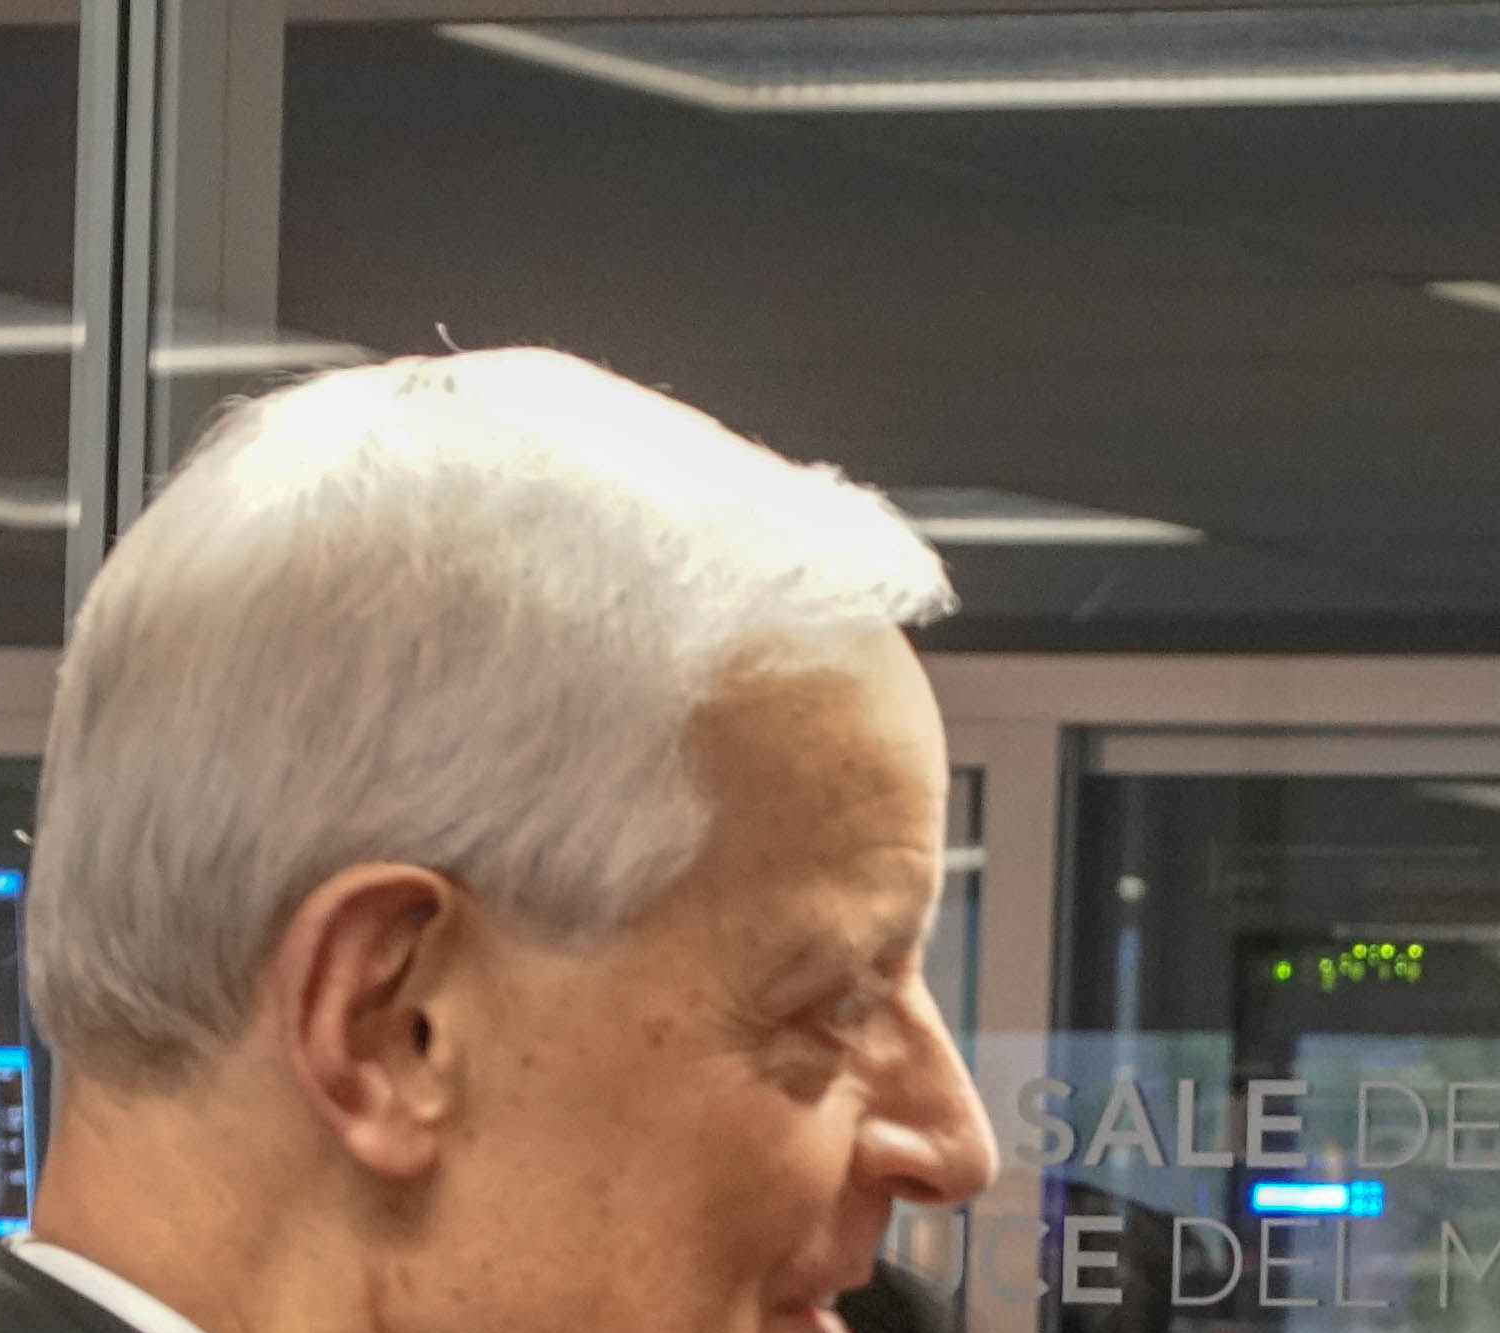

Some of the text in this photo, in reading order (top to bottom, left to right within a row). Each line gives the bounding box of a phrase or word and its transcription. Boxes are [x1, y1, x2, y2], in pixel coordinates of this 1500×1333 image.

[1014, 1077, 1310, 1169] SALE
[896, 1213, 1124, 1304] UCE
[1171, 1216, 1390, 1308] DEL
